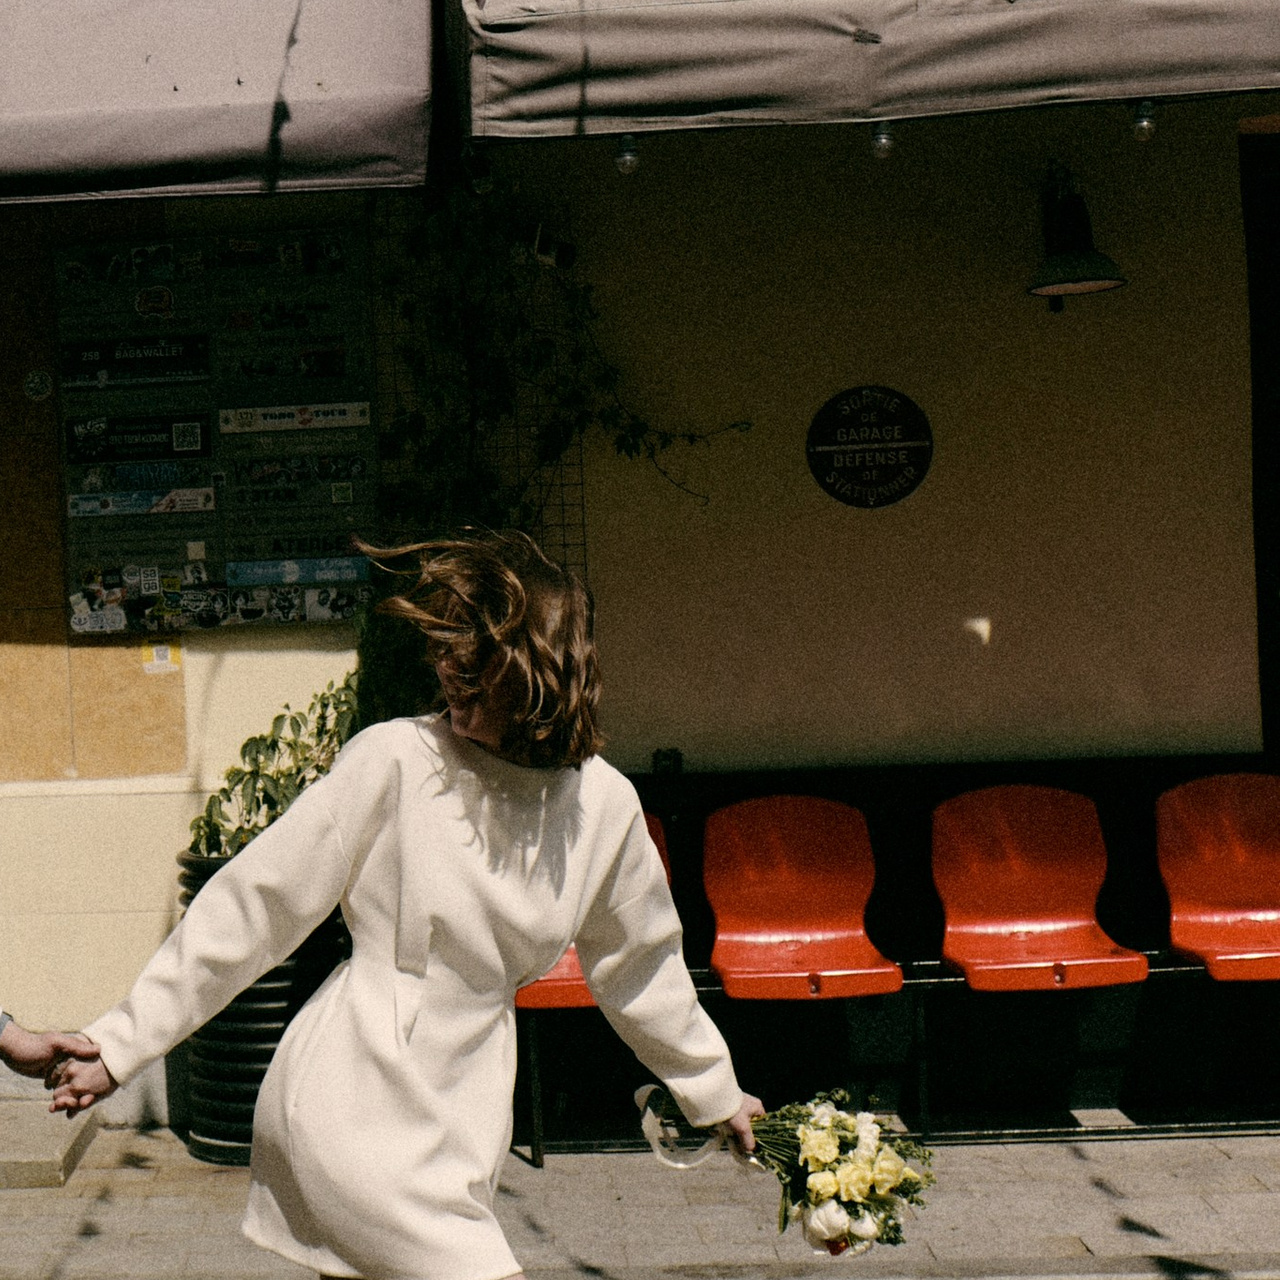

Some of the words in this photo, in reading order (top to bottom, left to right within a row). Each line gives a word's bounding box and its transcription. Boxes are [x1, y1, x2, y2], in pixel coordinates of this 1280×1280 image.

[114, 346, 185, 360] BAG&WALLET
[839, 392, 902, 415] SORTIE
[860, 412, 878, 423] DE
[836, 425, 903, 442] GARAGE
[825, 466, 917, 500] STATIONNER
[143, 569, 157, 578] sa
[144, 581, 158, 593] ga
